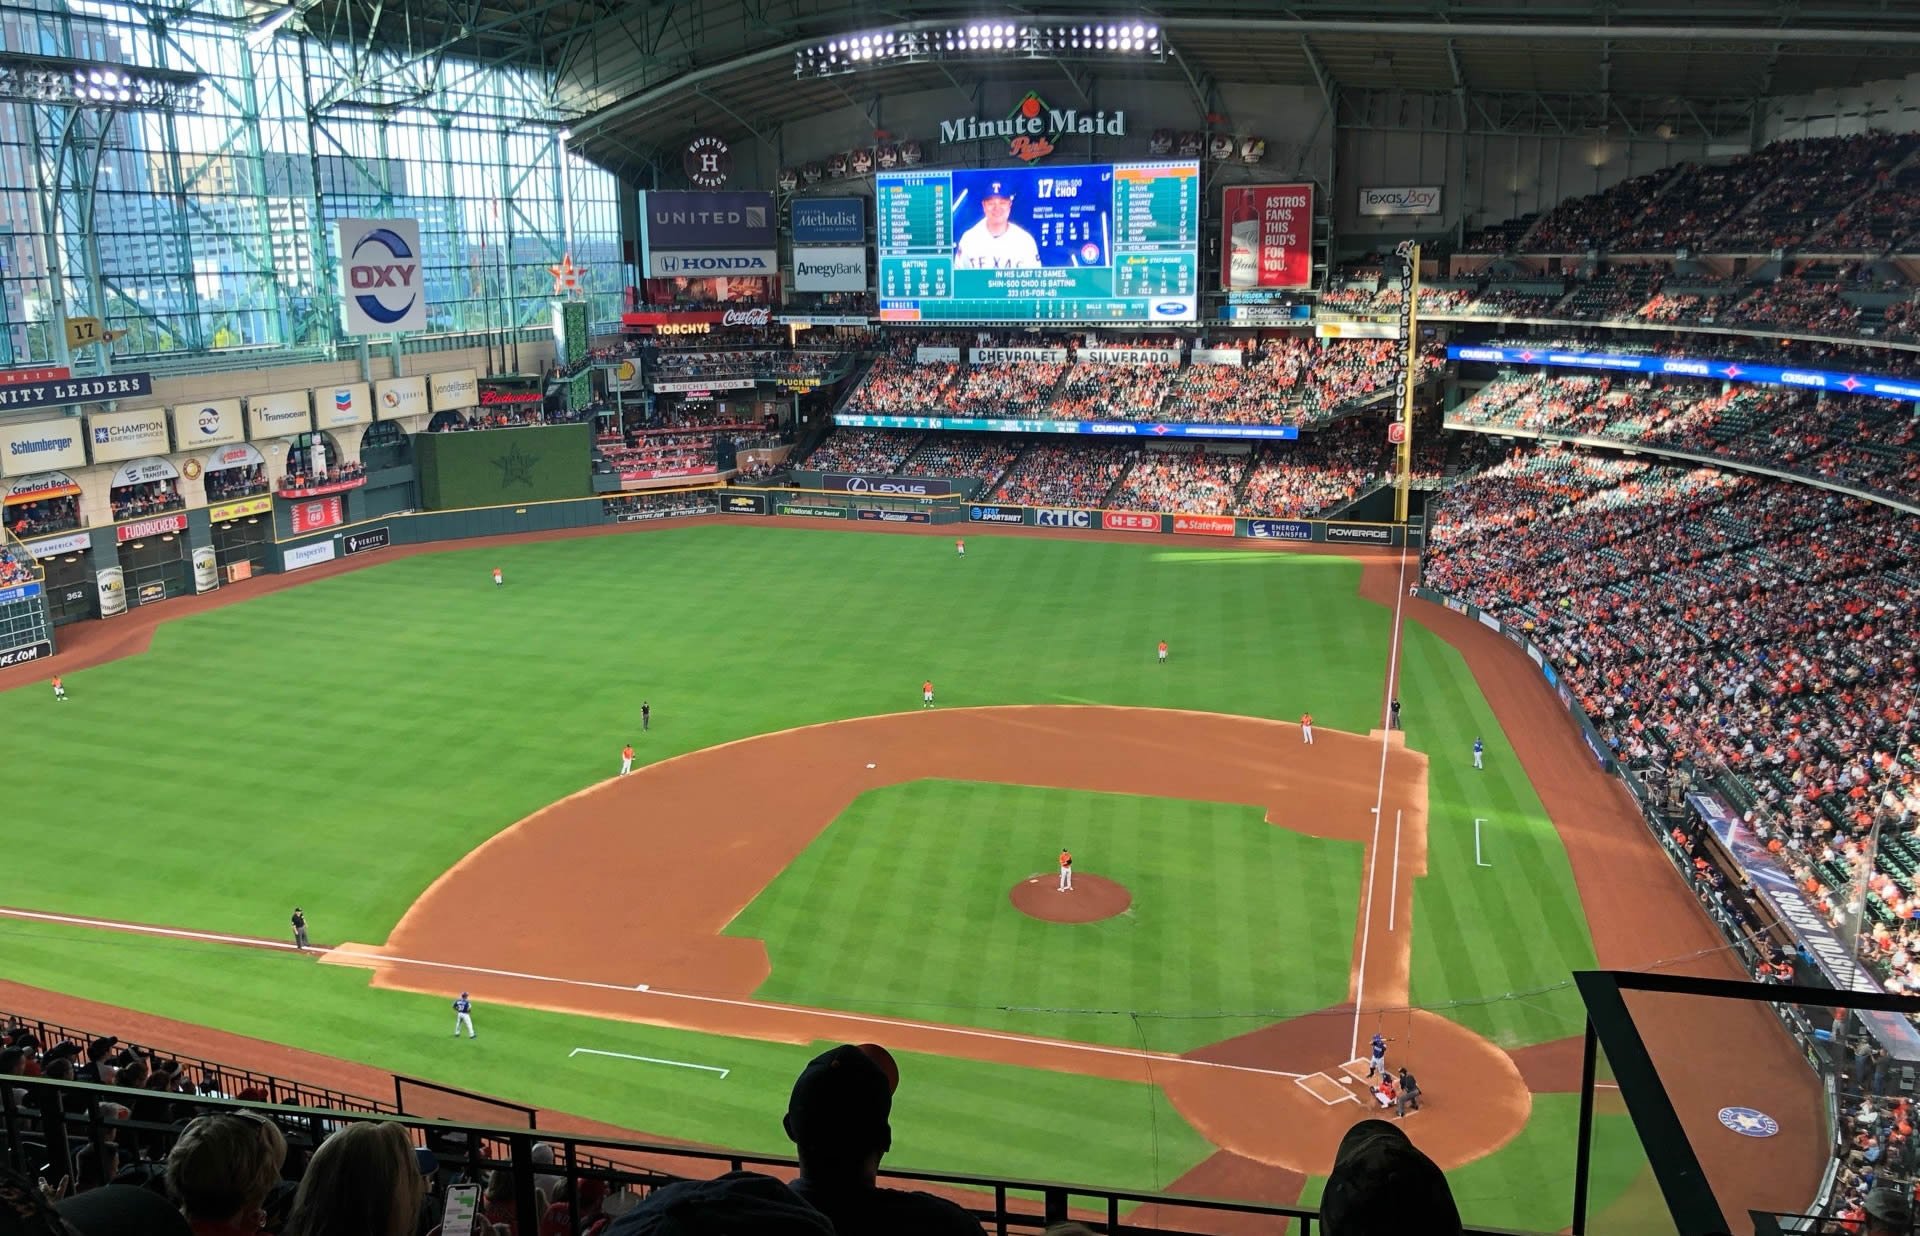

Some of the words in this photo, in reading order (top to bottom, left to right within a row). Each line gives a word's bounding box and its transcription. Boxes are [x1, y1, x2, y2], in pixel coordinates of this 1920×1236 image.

[939, 114, 1042, 144] Minute
[1049, 109, 1125, 136] Maid
[688, 137, 728, 153] HOUSTON
[700, 154, 719, 172] H
[692, 173, 727, 187] ASTROS
[1102, 172, 1110, 181] LF
[1038, 179, 1053, 198] 17
[1055, 187, 1077, 197] CHOO
[1266, 196, 1306, 208] ASTROS
[1365, 190, 1402, 205] Texas
[1402, 187, 1436, 207] Bay
[656, 211, 741, 225] UNITED
[798, 212, 857, 227] Methodist
[1265, 209, 1295, 221] FANS,
[1265, 222, 1289, 233] THIS
[1265, 234, 1296, 246] BUD'S
[1264, 247, 1285, 258] FOR
[682, 257, 768, 270] HONDA
[902, 260, 928, 268] BATTING
[1264, 259, 1288, 271] YOU.
[797, 262, 862, 278] AmegyBank
[1016, 270, 1033, 278] LAST
[1035, 270, 1041, 278] 12
[351, 264, 417, 289] OXY
[988, 280, 1019, 288] SHIN-SOO
[1021, 280, 1039, 288] CHOO
[74, 323, 94, 339] 17
[656, 323, 711, 335] TORCHYS
[978, 350, 1057, 363] CHEVROLET
[1089, 351, 1170, 364] SILVERADO
[7, 372, 54, 382] MAID
[777, 378, 821, 387] PLUCKERS
[54, 378, 140, 398] LEADERS
[671, 383, 709, 391] TORCHYS
[714, 381, 739, 389] TACOS
[481, 390, 543, 405] Budweiser
[1396, 370, 1407, 421] FOUL
[198, 416, 220, 426] OXY
[264, 410, 307, 423] Transocean
[109, 421, 164, 436] CHAMPION
[1091, 425, 1137, 434] COUSHATTA
[11, 437, 72, 456] Schlumberger
[142, 464, 163, 473] ENERGY
[143, 470, 169, 480] TRANSFER
[13, 481, 49, 495] Crawford
[51, 478, 70, 488] Bock
[870, 483, 927, 495] LEXUS
[311, 511, 321, 522] 66
[791, 508, 813, 516] National
[982, 513, 1022, 522] SPORTSNET
[1037, 509, 1090, 528] RTIC
[125, 516, 179, 539] FUDDRUCKERS
[1272, 524, 1301, 533] ENERGY
[1329, 528, 1389, 539] POWERADE
[1271, 530, 1308, 539] TRANSFER
[42, 542, 74, 553] AMERICA
[295, 546, 327, 560] Insperity
[66, 591, 83, 601] 362
[1769, 890, 1828, 933] ASTROS
